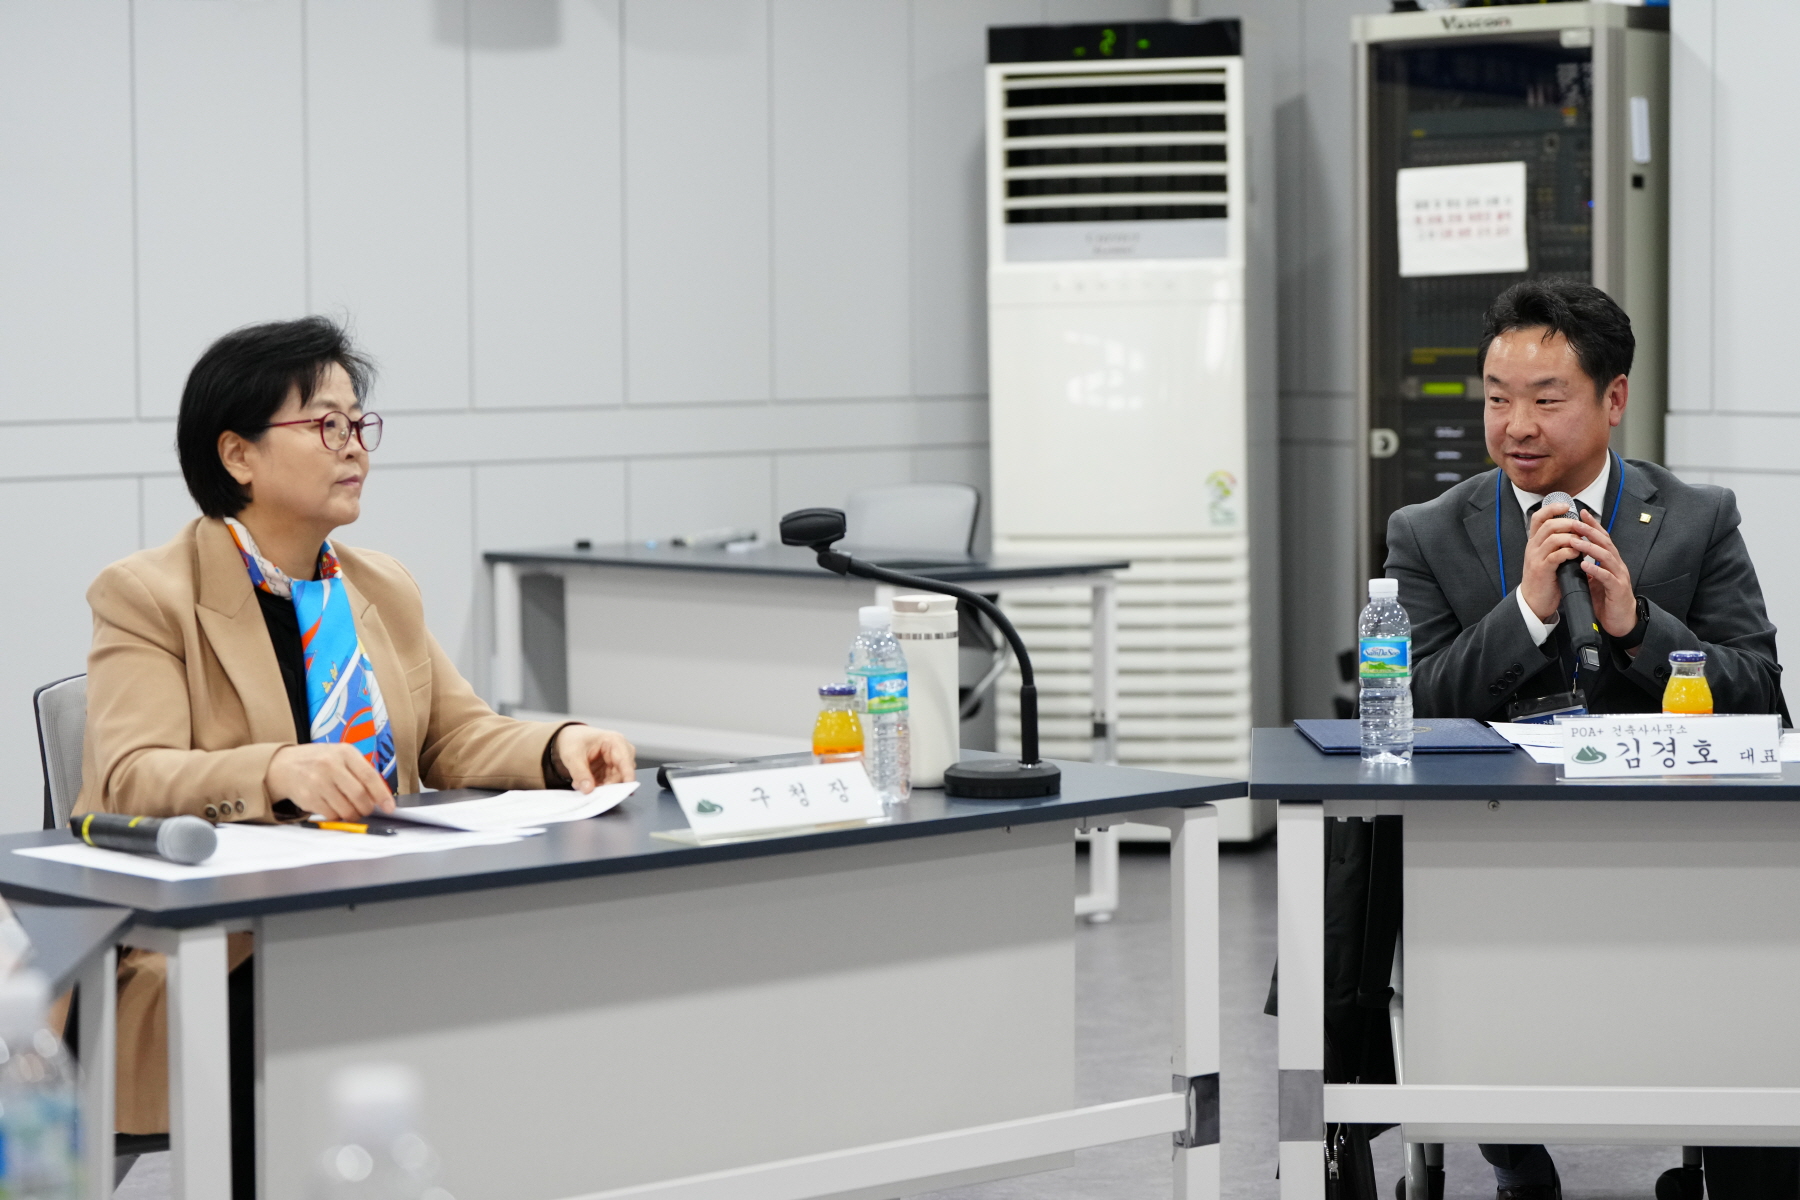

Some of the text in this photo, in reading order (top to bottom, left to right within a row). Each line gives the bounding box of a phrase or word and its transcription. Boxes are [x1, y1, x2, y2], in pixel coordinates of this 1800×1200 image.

[1571, 723, 1688, 738] POA+ 건축사사무소
[1740, 747, 1778, 766] 대표
